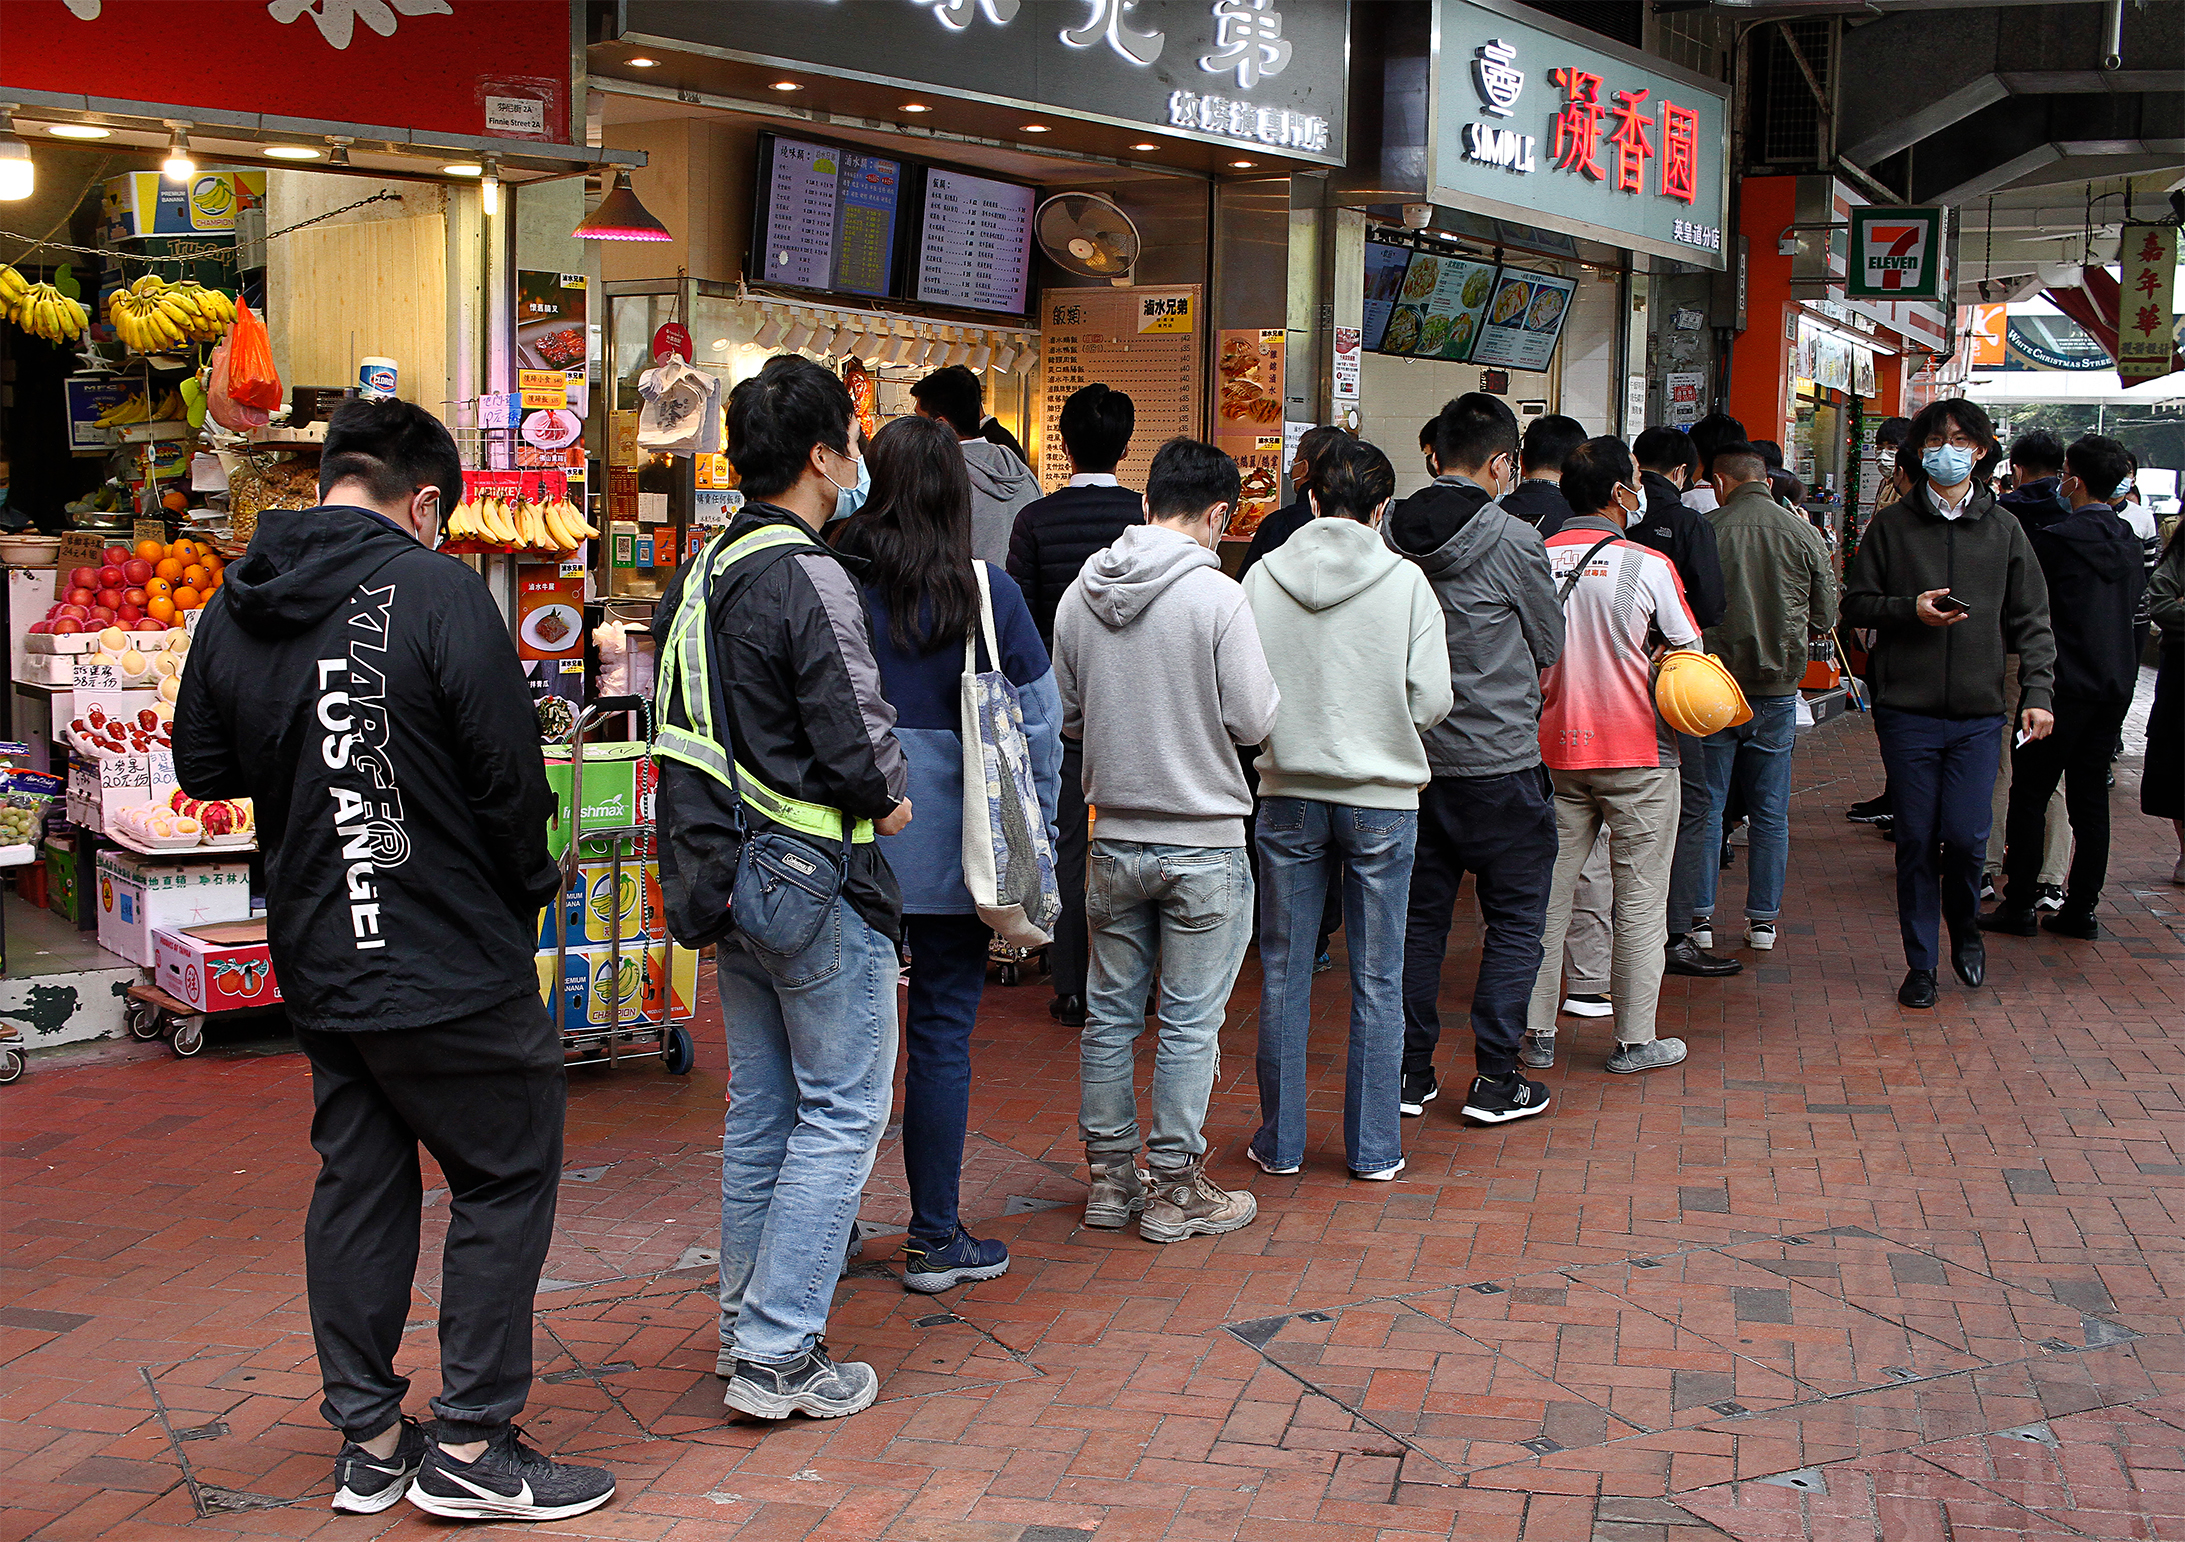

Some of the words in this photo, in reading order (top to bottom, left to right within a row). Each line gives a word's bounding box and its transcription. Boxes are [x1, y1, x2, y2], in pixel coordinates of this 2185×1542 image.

[488, 117, 509, 126] Finnie
[511, 119, 531, 128] Street
[531, 121, 541, 129] 2A
[1555, 67, 1699, 205] 凝香園
[1471, 122, 1536, 173] SIMPLE
[196, 219, 234, 227] CHAMPION
[1673, 218, 1721, 250] 英皇道分店
[1871, 226, 1919, 290] 7
[2132, 231, 2166, 338] 嘉年華
[1143, 298, 1188, 316] 滷水兄弟
[2007, 329, 2033, 354] WHITE
[2032, 348, 2081, 368] CHRISTMAS
[2081, 357, 2112, 368] STREE
[317, 658, 354, 770] LOS
[592, 1007, 638, 1020] CHAPION
